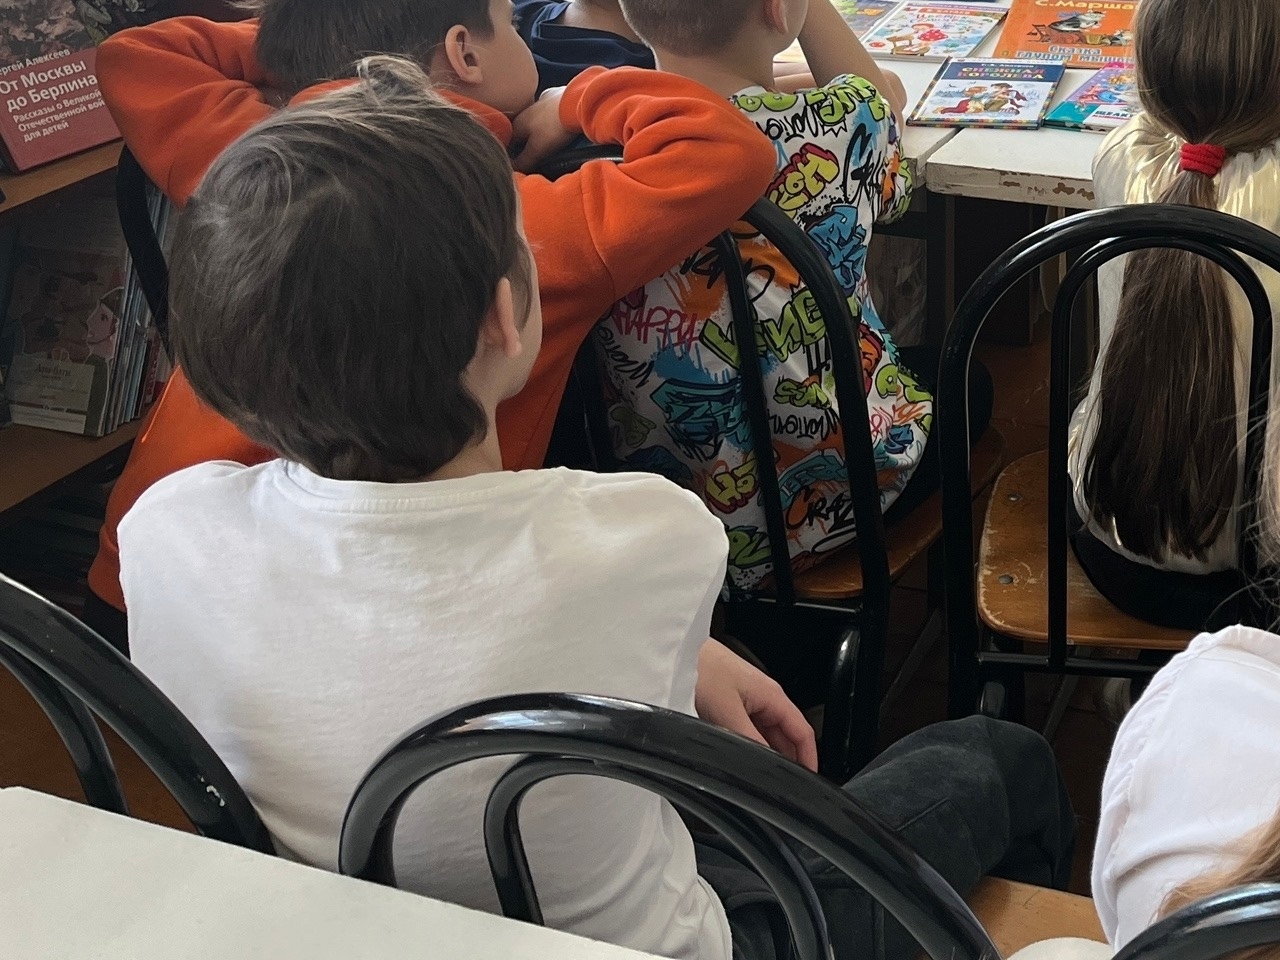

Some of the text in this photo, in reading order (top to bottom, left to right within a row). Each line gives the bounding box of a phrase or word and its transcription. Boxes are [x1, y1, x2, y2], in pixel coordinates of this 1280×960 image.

[26, 48, 71, 67] Алексеев
[20, 60, 87, 89] Москвы
[6, 73, 98, 113] до Берлина
[12, 104, 56, 124] Рассказы
[62, 89, 102, 108] Великой
[18, 98, 105, 132] Отечественной вой
[23, 121, 69, 143] для детей
